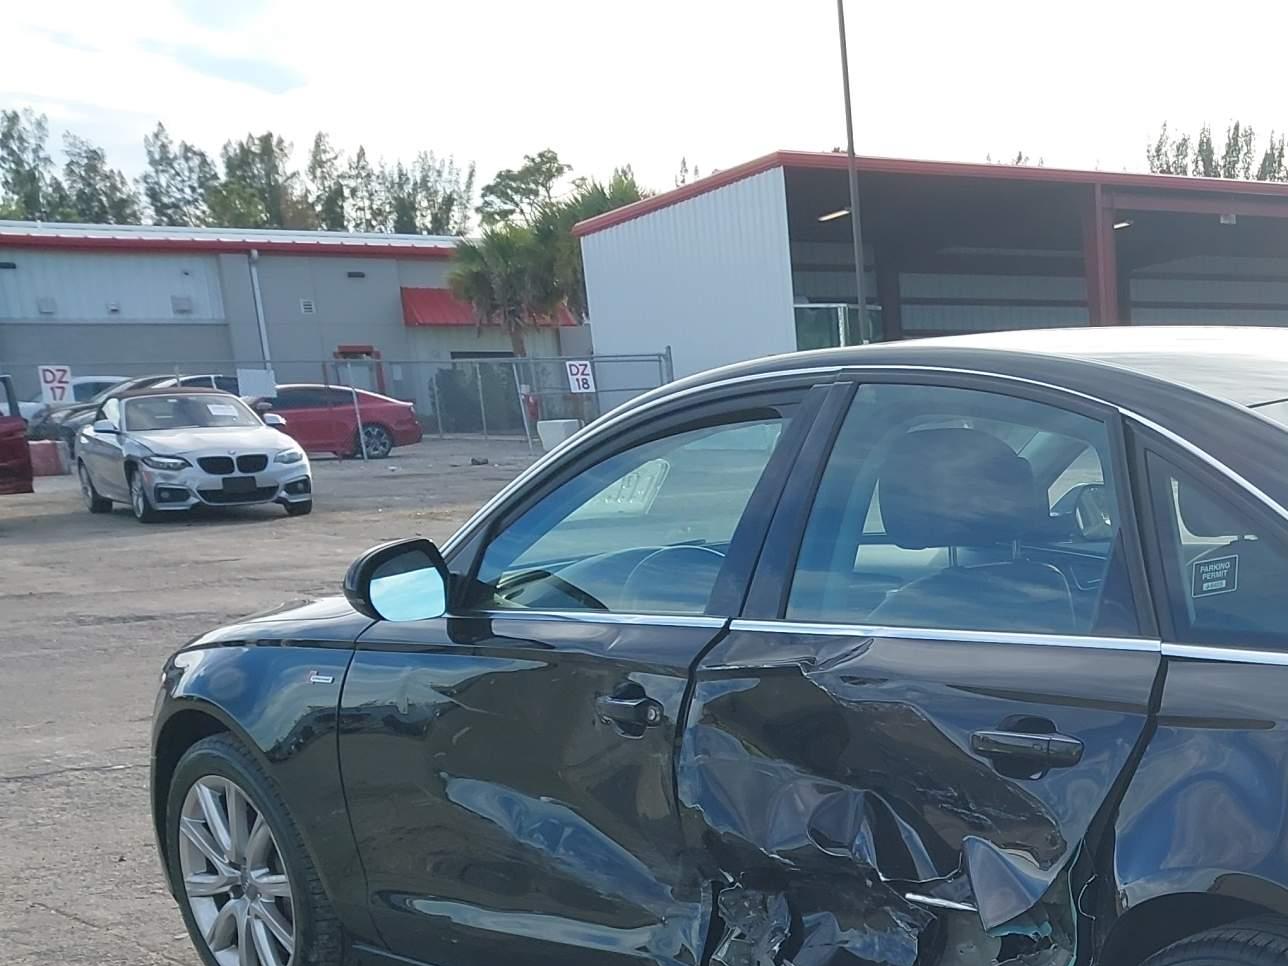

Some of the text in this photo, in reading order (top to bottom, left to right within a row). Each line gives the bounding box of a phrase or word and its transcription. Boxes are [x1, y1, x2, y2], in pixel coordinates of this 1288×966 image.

[42, 368, 69, 384] DZ
[568, 363, 590, 376] DZ
[575, 377, 590, 390] 18
[50, 386, 65, 401] 17
[1200, 561, 1230, 575] PARKING
[1202, 569, 1228, 581] PERMIT
